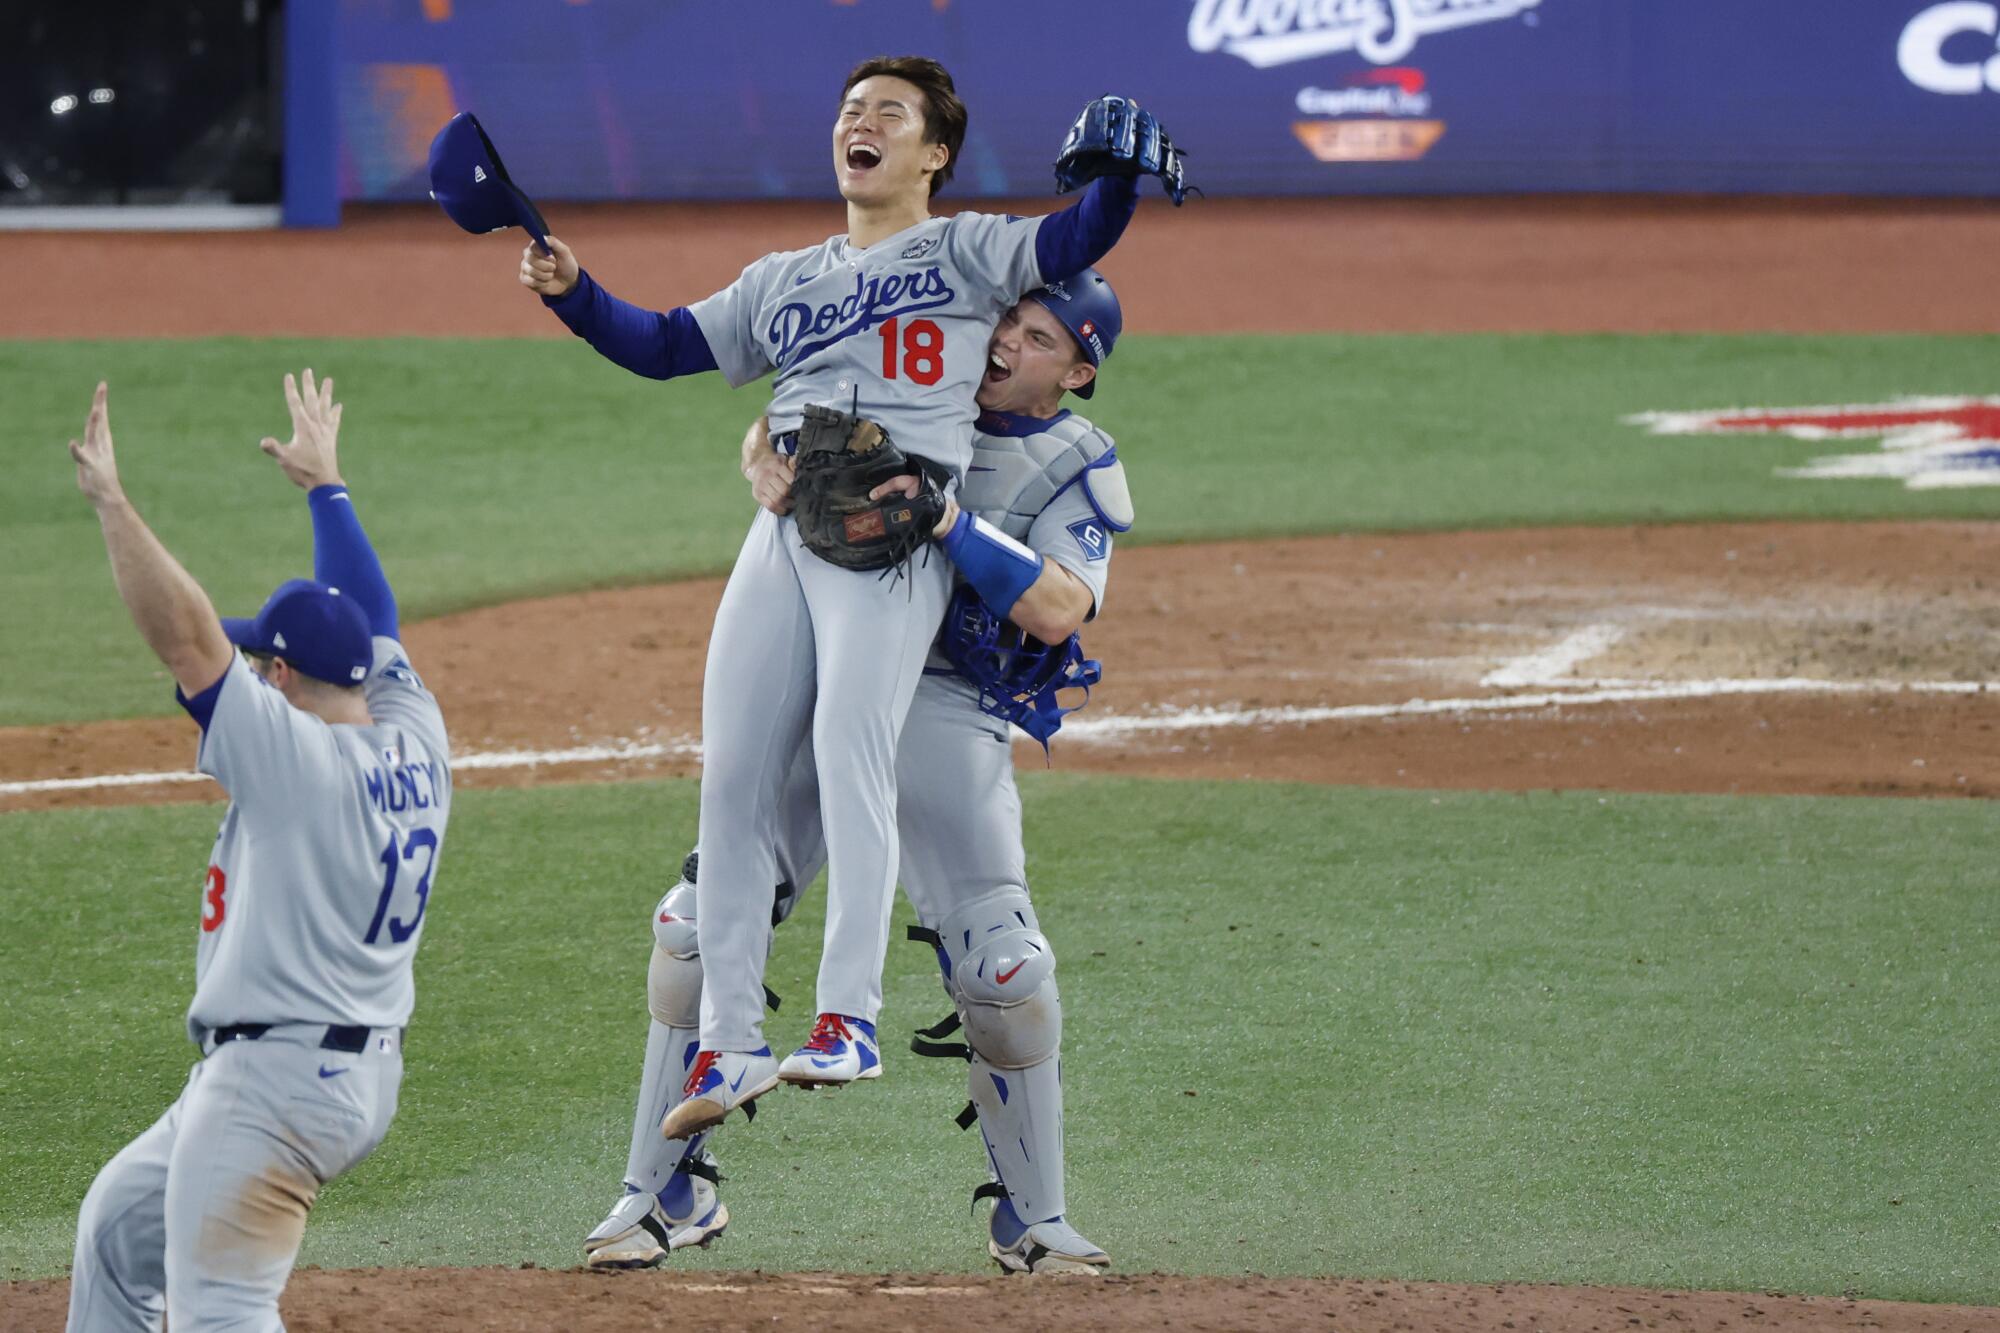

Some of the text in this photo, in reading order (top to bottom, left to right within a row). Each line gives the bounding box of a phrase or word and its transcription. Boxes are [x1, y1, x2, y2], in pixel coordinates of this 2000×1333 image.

[1897, 1, 2000, 95] C
[769, 267, 954, 369] Dodgers
[879, 317, 944, 386] 18
[364, 828, 437, 944] 13
